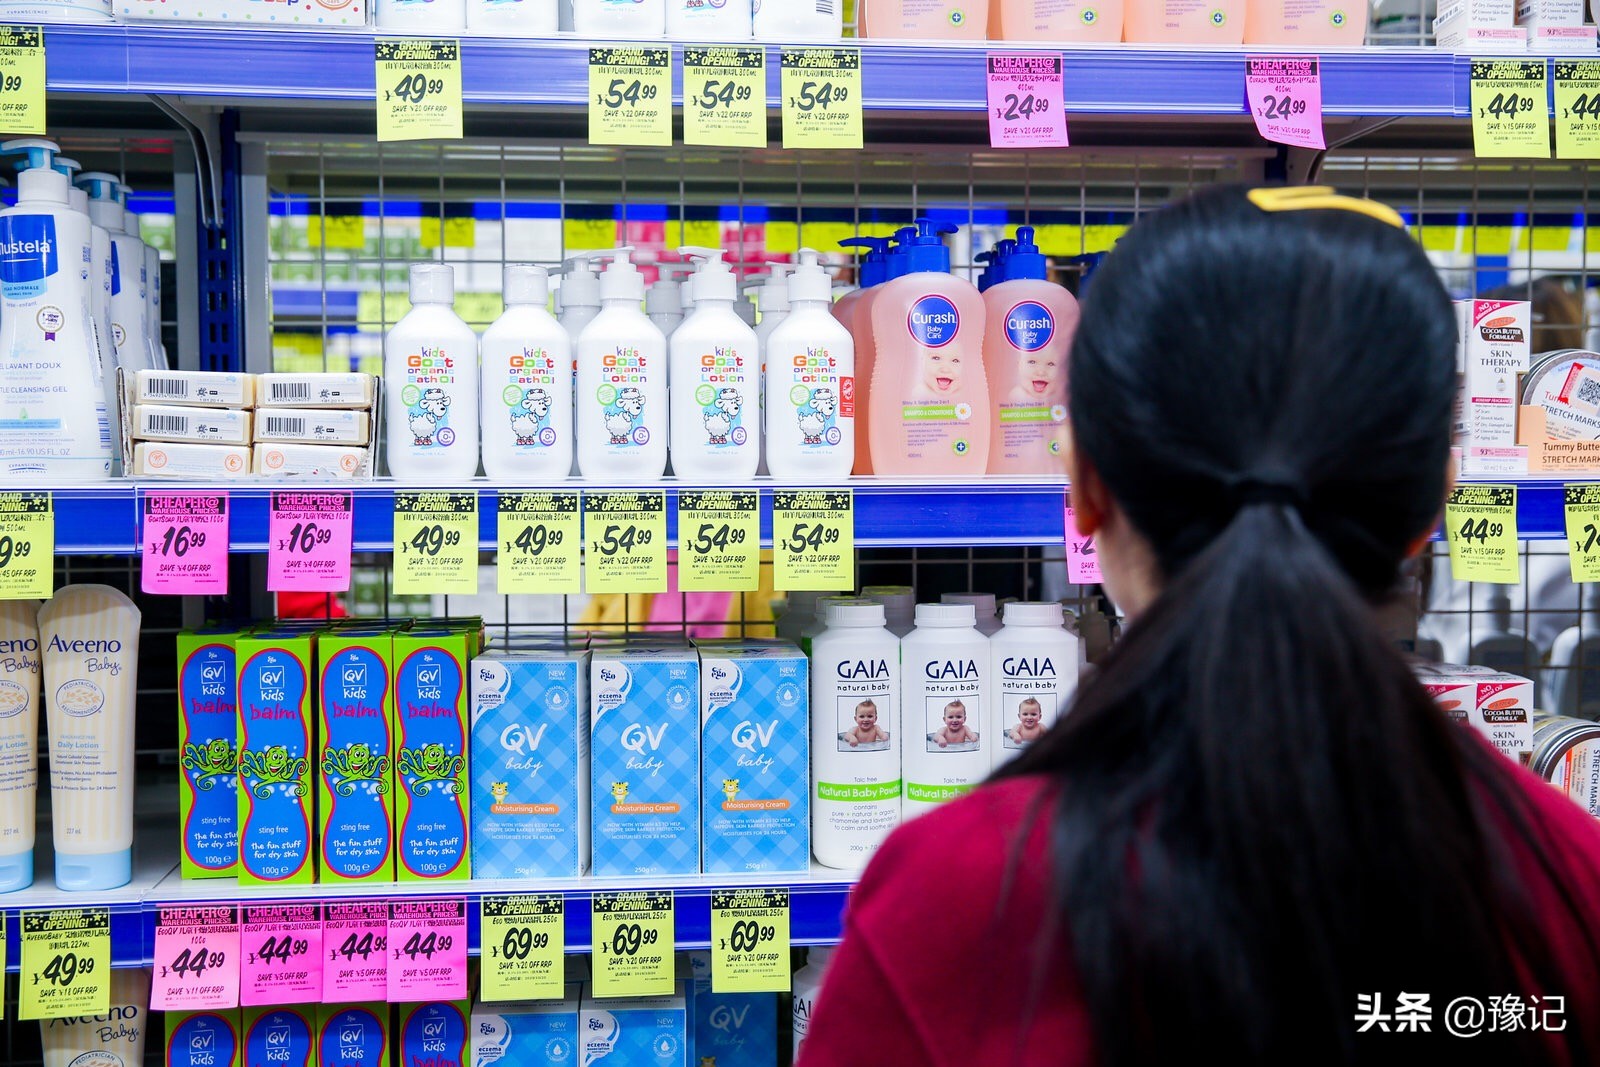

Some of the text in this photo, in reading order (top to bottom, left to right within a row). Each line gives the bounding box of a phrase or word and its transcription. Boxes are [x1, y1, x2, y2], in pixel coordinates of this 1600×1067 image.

[399, 41, 431, 50] GRAND
[393, 50, 437, 59] OPENING!
[707, 47, 739, 57] GRAND
[702, 57, 743, 66] OPENING!
[993, 58, 1055, 67] CHEAPER@
[1251, 60, 1311, 69] CHEAPER@
[1492, 62, 1521, 70] GRAND
[1487, 71, 1527, 79] OPENING!
[912, 312, 955, 324] Curash
[1008, 318, 1051, 329] Curash
[927, 326, 942, 334] Baby
[422, 347, 445, 357] kids
[616, 346, 639, 356] kids
[715, 346, 736, 356] kids
[1491, 350, 1512, 358] SKIN
[408, 356, 453, 367] Goat
[510, 356, 554, 367] Goat
[603, 356, 646, 366] Goat
[702, 355, 743, 366] Goat
[794, 355, 836, 367] Goat
[1481, 359, 1522, 367] THERAPY
[408, 367, 454, 375] organic
[603, 365, 646, 374] organic
[702, 366, 743, 374] organic
[603, 373, 646, 382] Lotion
[1541, 404, 1573, 420] TRETCH
[1543, 443, 1574, 453] Tummy
[701, 492, 733, 500] GRAND
[1463, 487, 1492, 495] GRAND
[150, 497, 219, 508] CHEAPER@
[278, 494, 345, 505] CHEAPER@
[418, 493, 450, 502] GRAND
[1458, 496, 1496, 504] OPENING!
[412, 502, 455, 511] OPENING!
[696, 500, 739, 509] OPENING!
[47, 634, 122, 653] Aveeno
[85, 658, 119, 675] Baby
[837, 659, 889, 679] GAIA
[926, 659, 979, 679] GAIA
[1003, 657, 1056, 677] GAIA
[203, 667, 222, 680] QV
[262, 672, 281, 685] QV
[345, 669, 363, 682] QV
[202, 684, 225, 695] kids
[872, 682, 890, 691] baby
[960, 683, 979, 692] baby
[1035, 681, 1056, 689] baby
[261, 689, 284, 701] kids
[343, 688, 366, 699] kids
[192, 699, 237, 714] balm
[333, 702, 378, 718] balm
[251, 704, 296, 720] balm
[500, 722, 548, 756] QV
[621, 722, 668, 756] QV
[732, 719, 779, 753] QV
[58, 741, 77, 749] Daily
[505, 754, 544, 778] baby
[625, 754, 664, 777] baby
[737, 752, 774, 775] baby
[1590, 750, 1600, 813] STRETCH MARKS
[820, 786, 877, 798] Natural Baby
[909, 787, 940, 798] Natural
[495, 804, 555, 813] Moisturising Cream
[616, 804, 675, 813] Moisturising Cream
[259, 826, 275, 834] sting
[267, 841, 280, 849] fun
[281, 840, 301, 848] stuff
[254, 850, 299, 860] for dry skin
[262, 866, 279, 875] 100g
[514, 867, 529, 875] 250g
[507, 896, 538, 905] GRAND
[616, 892, 648, 902] GRAND
[248, 904, 315, 917] CHEAPER@
[393, 900, 459, 913] CHEAPER@
[501, 904, 544, 915] OPENING!
[611, 900, 653, 911] OPENING!
[49, 909, 82, 921] GRAND
[161, 906, 231, 919] CHEAPER@
[43, 919, 90, 929] OPENING!
[529, 961, 540, 969] OFF
